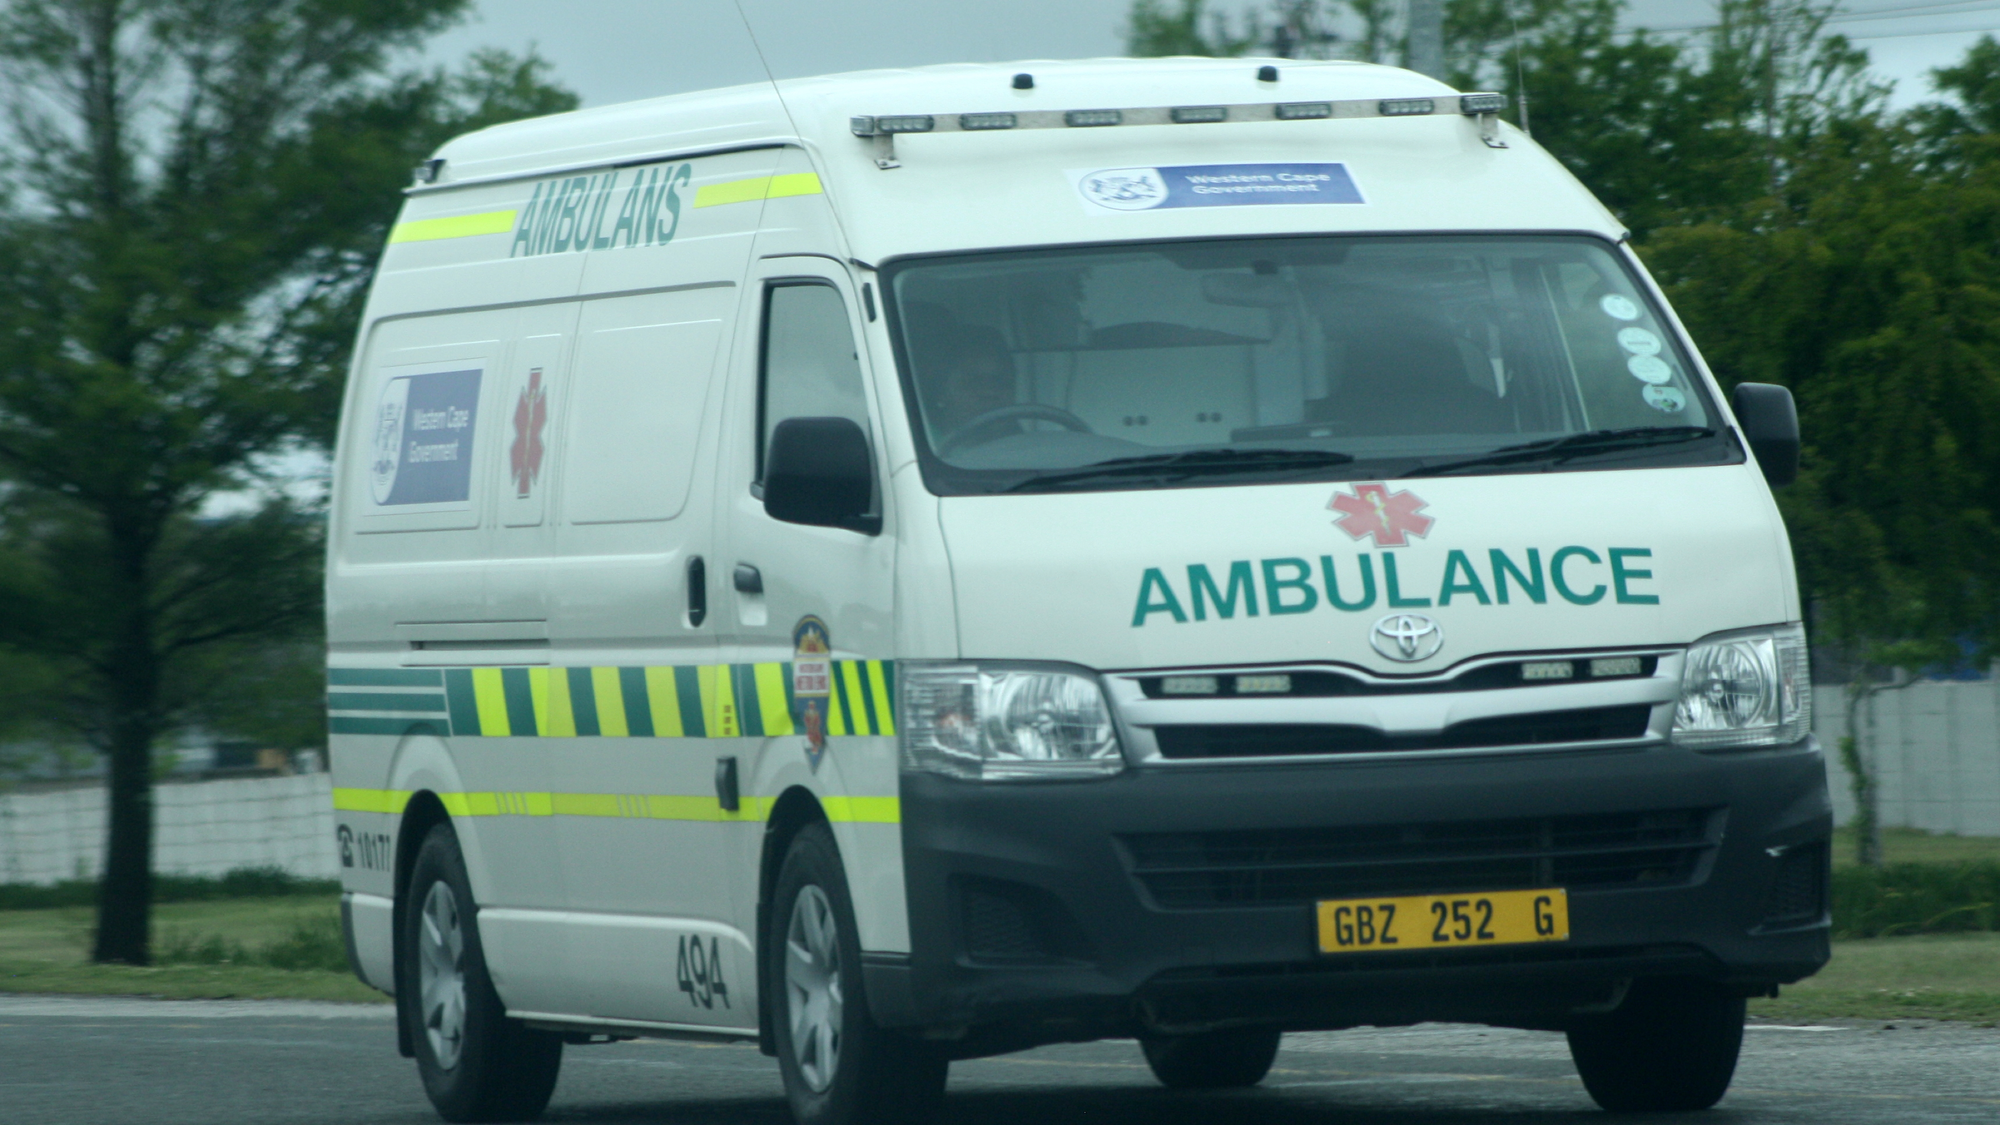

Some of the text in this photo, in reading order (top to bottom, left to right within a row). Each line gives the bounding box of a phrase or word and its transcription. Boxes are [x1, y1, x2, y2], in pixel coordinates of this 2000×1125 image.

[1185, 172, 1331, 184] Western Cape
[1192, 183, 1320, 195] Government
[509, 163, 692, 259] AMBULANS
[1130, 545, 1660, 628] AMBULANCE
[357, 831, 391, 873] 10177
[1334, 895, 1554, 946] GBZ 252 G
[676, 933, 731, 1010] 494
